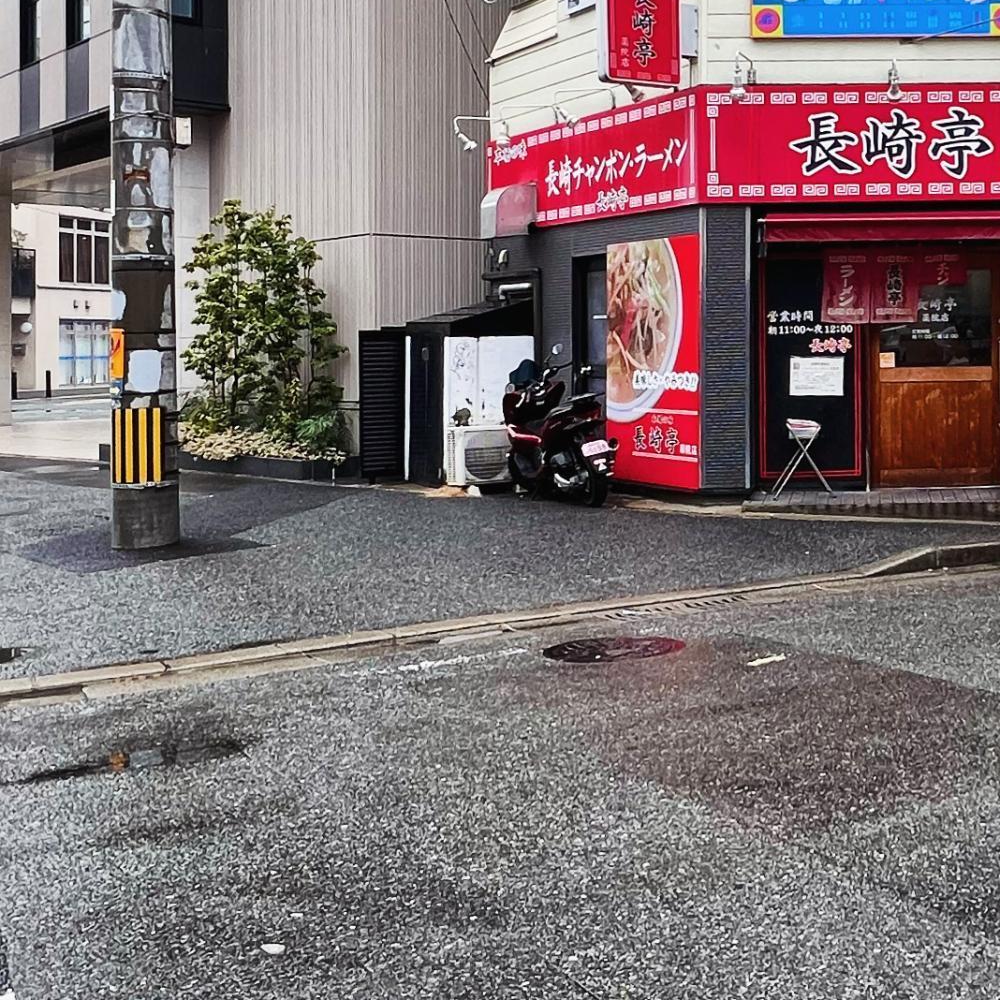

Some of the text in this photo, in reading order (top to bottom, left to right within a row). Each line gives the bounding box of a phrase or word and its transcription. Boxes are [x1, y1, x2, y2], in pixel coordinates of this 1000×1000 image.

[787, 106, 995, 180] 長崎亭
[838, 264, 856, 307] ラーメン
[886, 262, 904, 307] 長崎亭
[766, 310, 815, 323] 営業時間
[808, 336, 853, 354] 長崎亭
[633, 425, 680, 454] 長崎亭
